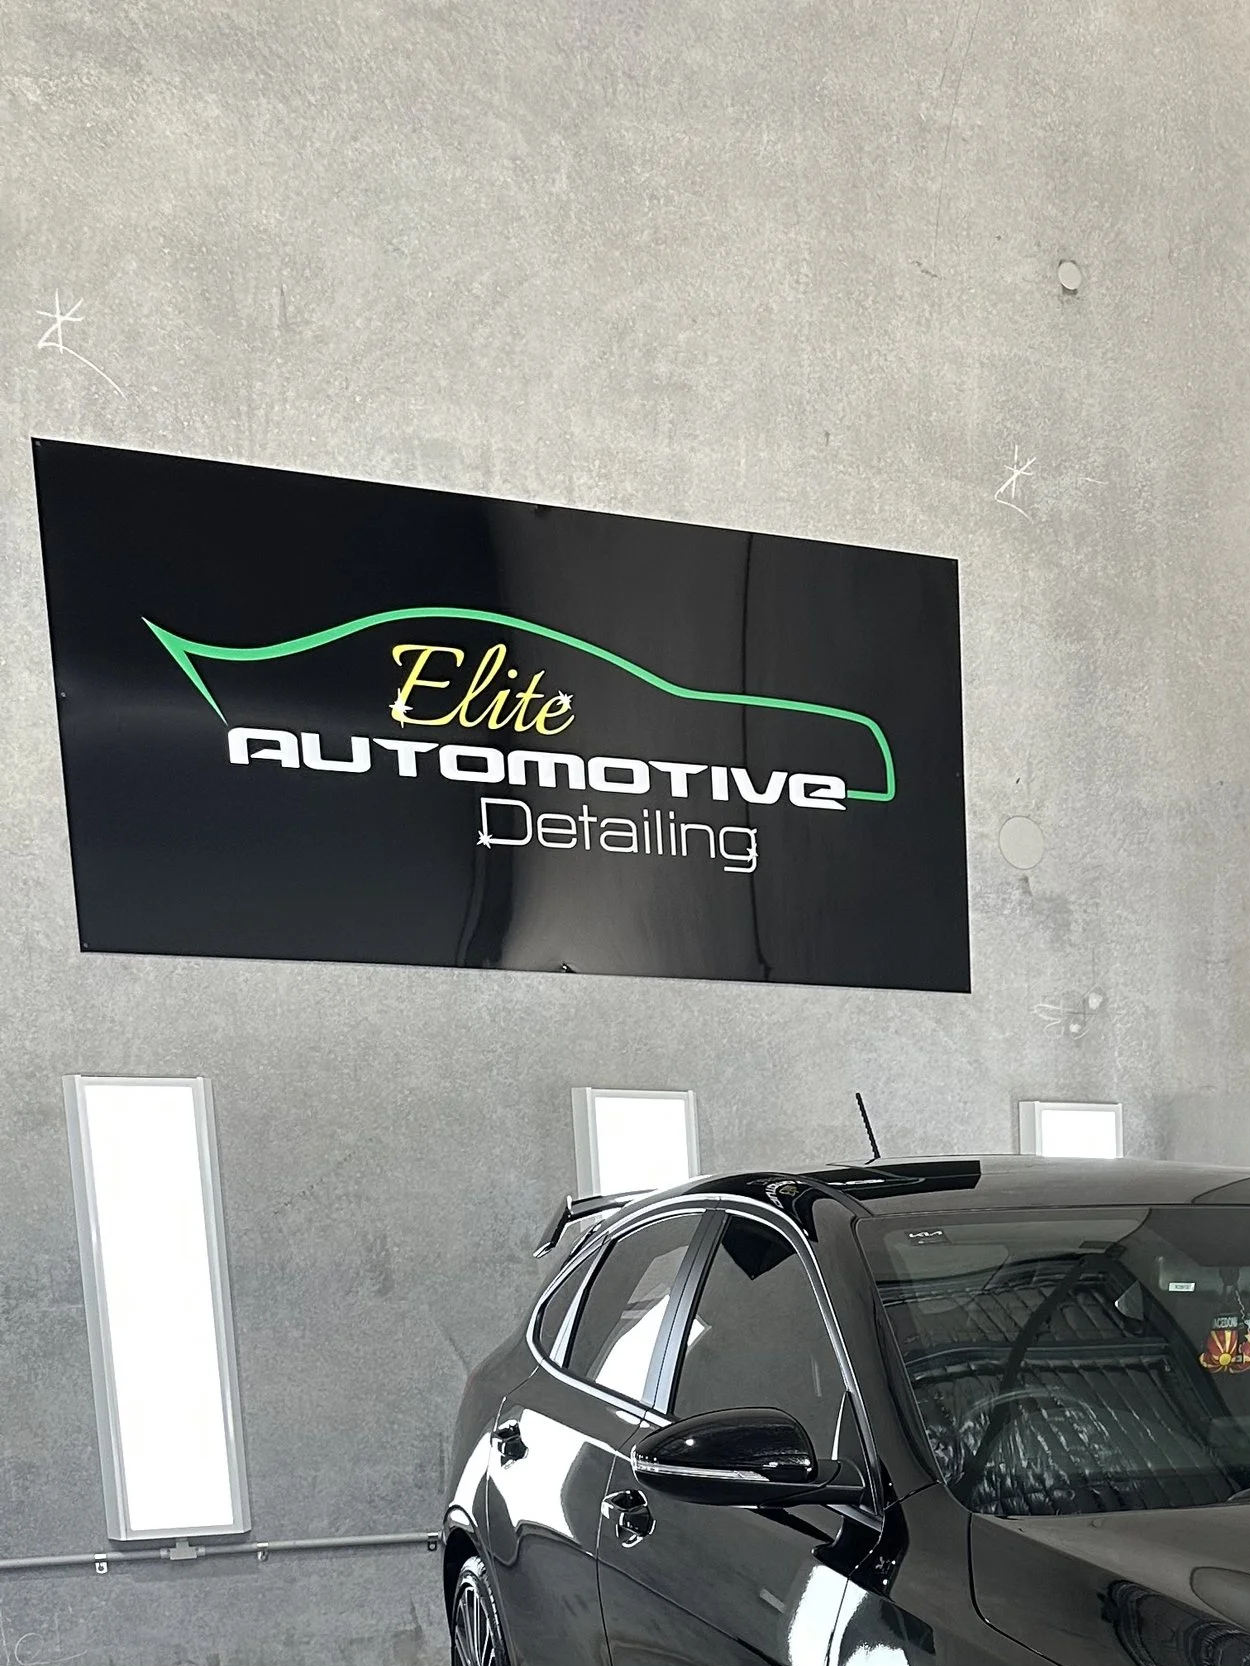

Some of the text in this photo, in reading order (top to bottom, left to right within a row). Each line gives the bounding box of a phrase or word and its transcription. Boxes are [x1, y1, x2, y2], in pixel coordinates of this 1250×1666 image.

[391, 643, 576, 735] Elite
[227, 726, 848, 811] AUTOMOTIVE
[479, 796, 759, 874] Detailing
